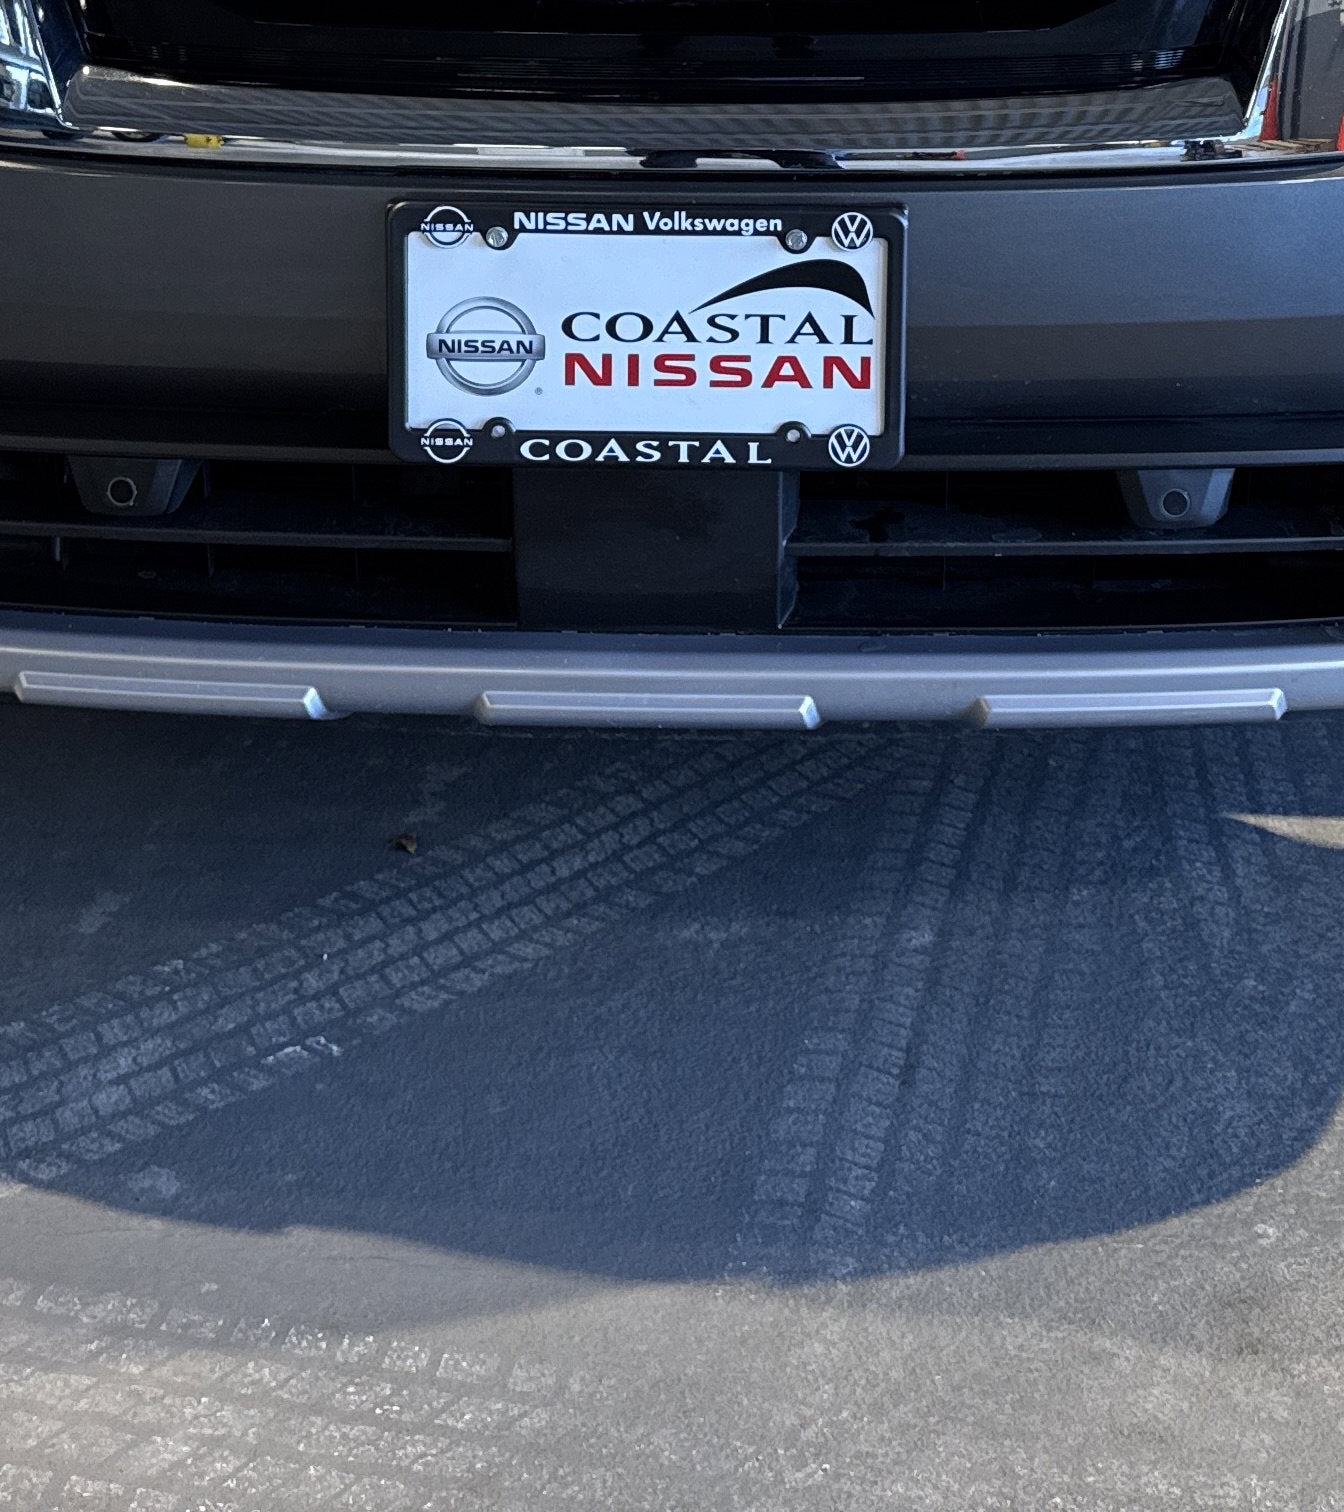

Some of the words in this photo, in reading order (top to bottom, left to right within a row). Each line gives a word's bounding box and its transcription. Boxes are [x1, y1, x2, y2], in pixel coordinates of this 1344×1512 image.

[420, 222, 474, 232] NISSAN
[513, 211, 635, 232] NISSAN
[642, 211, 783, 236] Volkswagen
[561, 309, 874, 346] COASTAL
[437, 337, 534, 355] NISSAN
[564, 351, 872, 389] NISSAN
[420, 436, 474, 447] NISSAN
[519, 437, 773, 465] COASTAL
